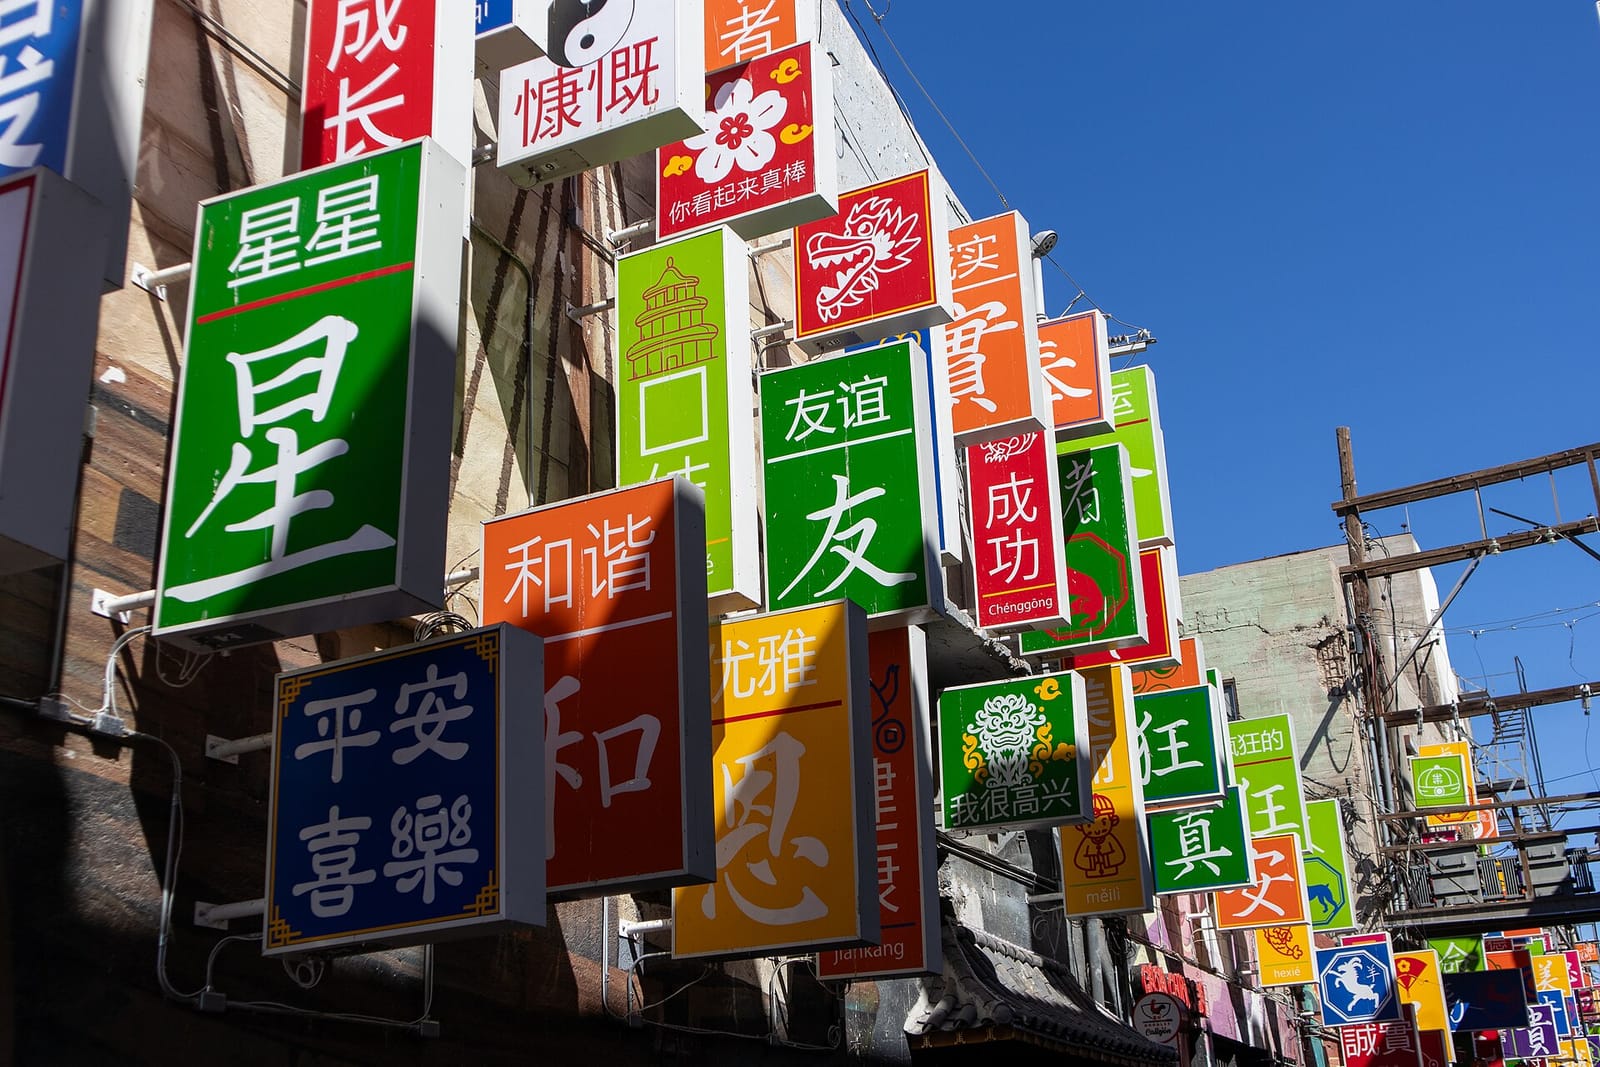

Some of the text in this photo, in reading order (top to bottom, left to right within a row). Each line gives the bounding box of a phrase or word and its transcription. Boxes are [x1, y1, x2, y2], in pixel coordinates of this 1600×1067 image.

[514, 36, 659, 147] 慷慨
[227, 175, 382, 288] 星星
[668, 160, 807, 225] 你看起来真棒
[164, 315, 396, 602] 星
[785, 375, 891, 442] 友谊
[503, 513, 656, 618] 和谐
[778, 475, 917, 600] 友
[985, 471, 1039, 584] 成功
[295, 664, 474, 783] 平安
[1136, 711, 1204, 786] 狂
[292, 794, 479, 918] 喜樂
[702, 731, 829, 926] 恩
[950, 777, 1072, 826] 我很高兴
[1366, 964, 1380, 983] 羊
